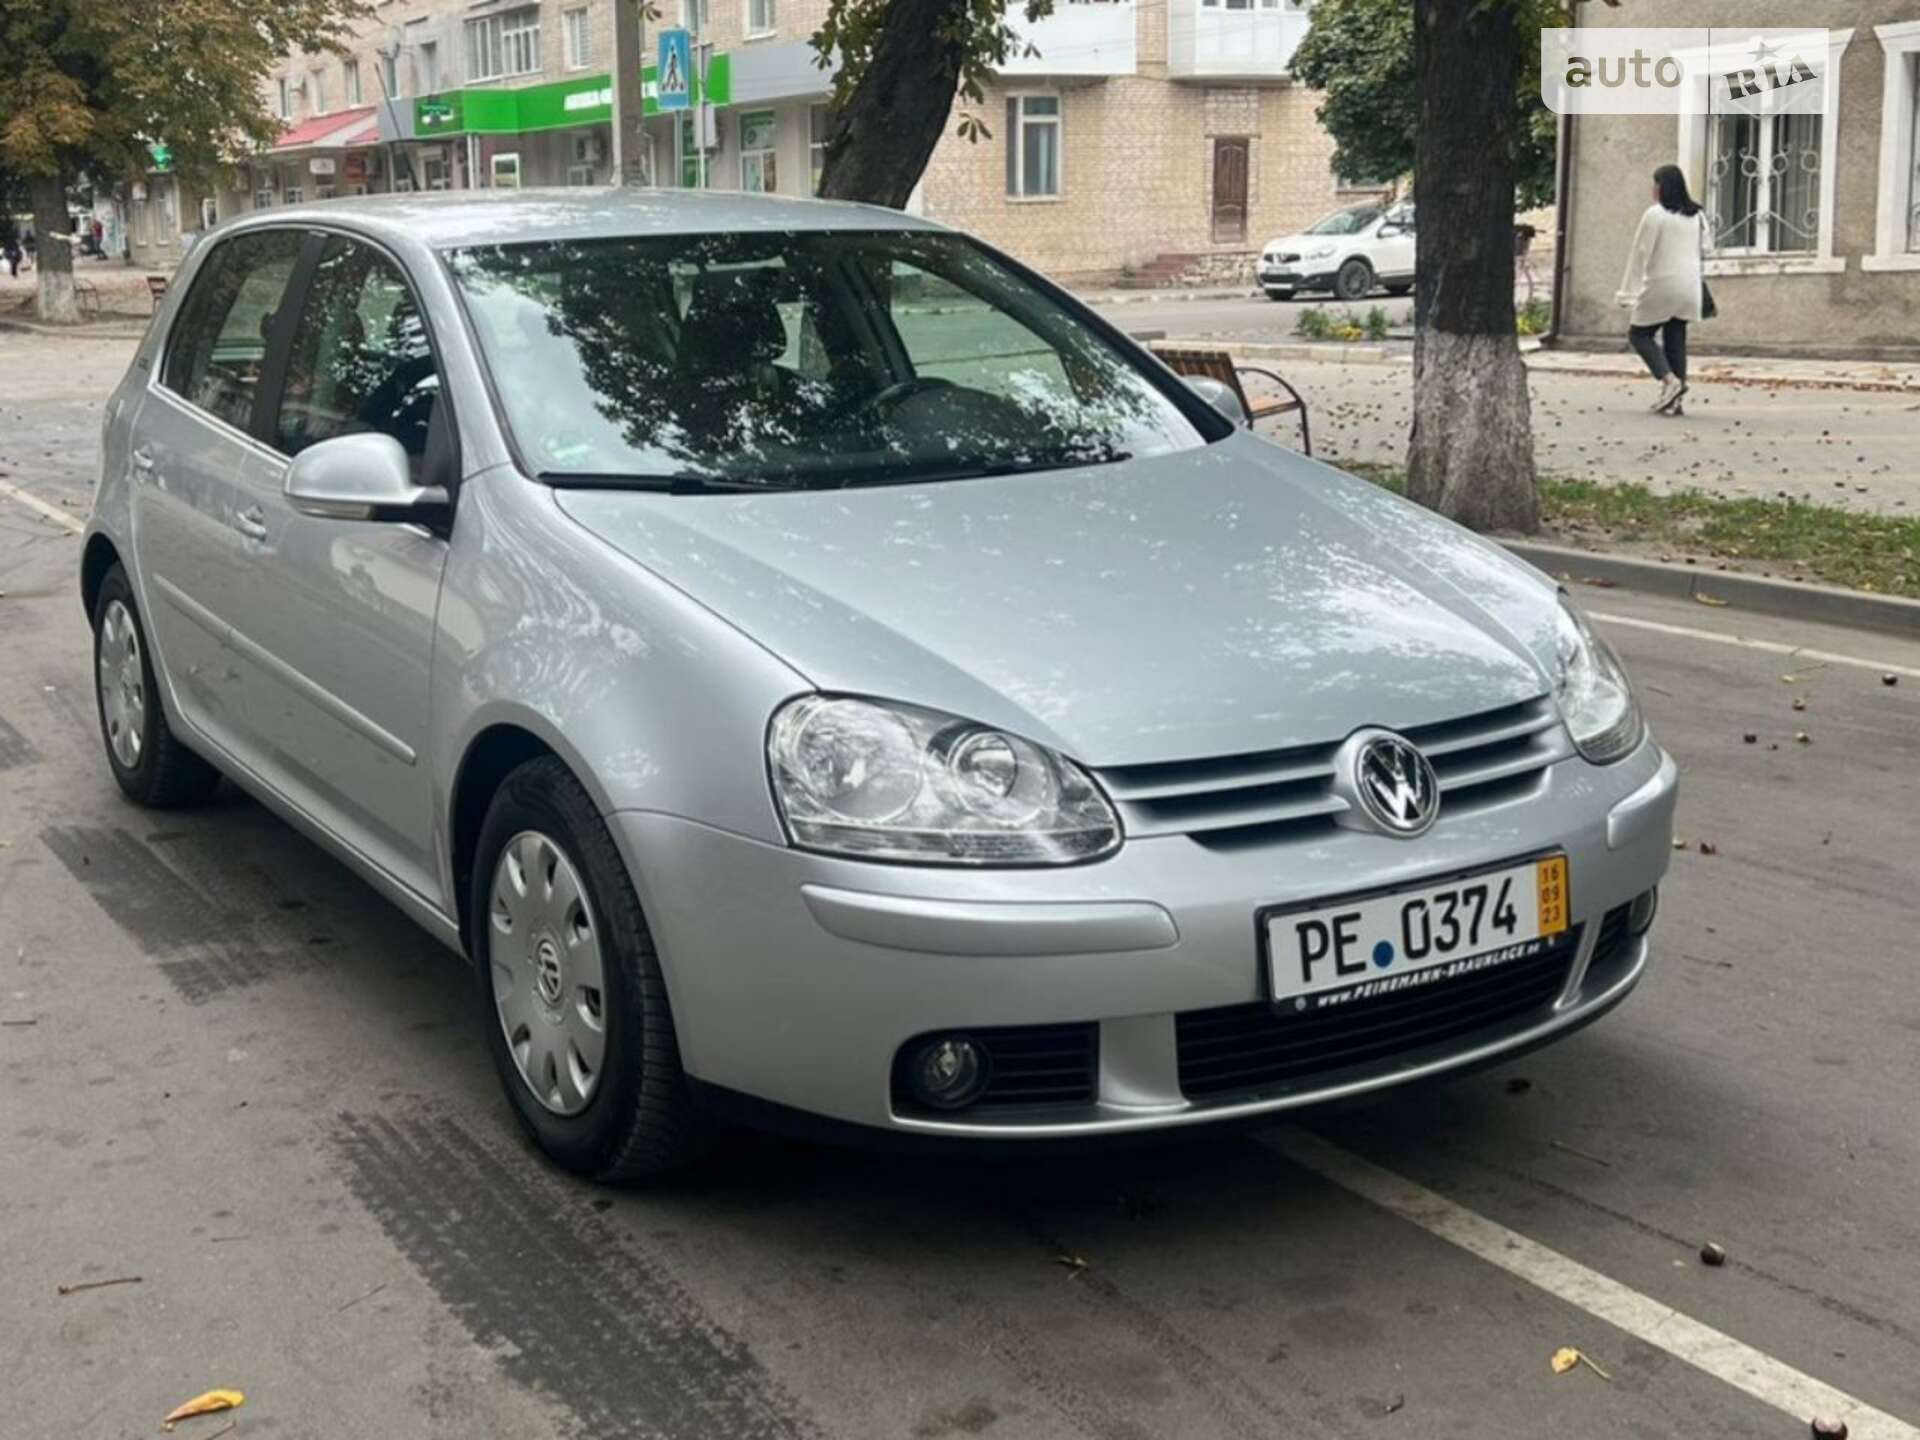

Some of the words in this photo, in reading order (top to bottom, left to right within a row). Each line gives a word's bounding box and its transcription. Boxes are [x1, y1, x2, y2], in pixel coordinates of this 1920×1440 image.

[1357, 738, 1430, 832] VW
[1296, 912, 1367, 983] PE
[1401, 877, 1517, 960] 0374
